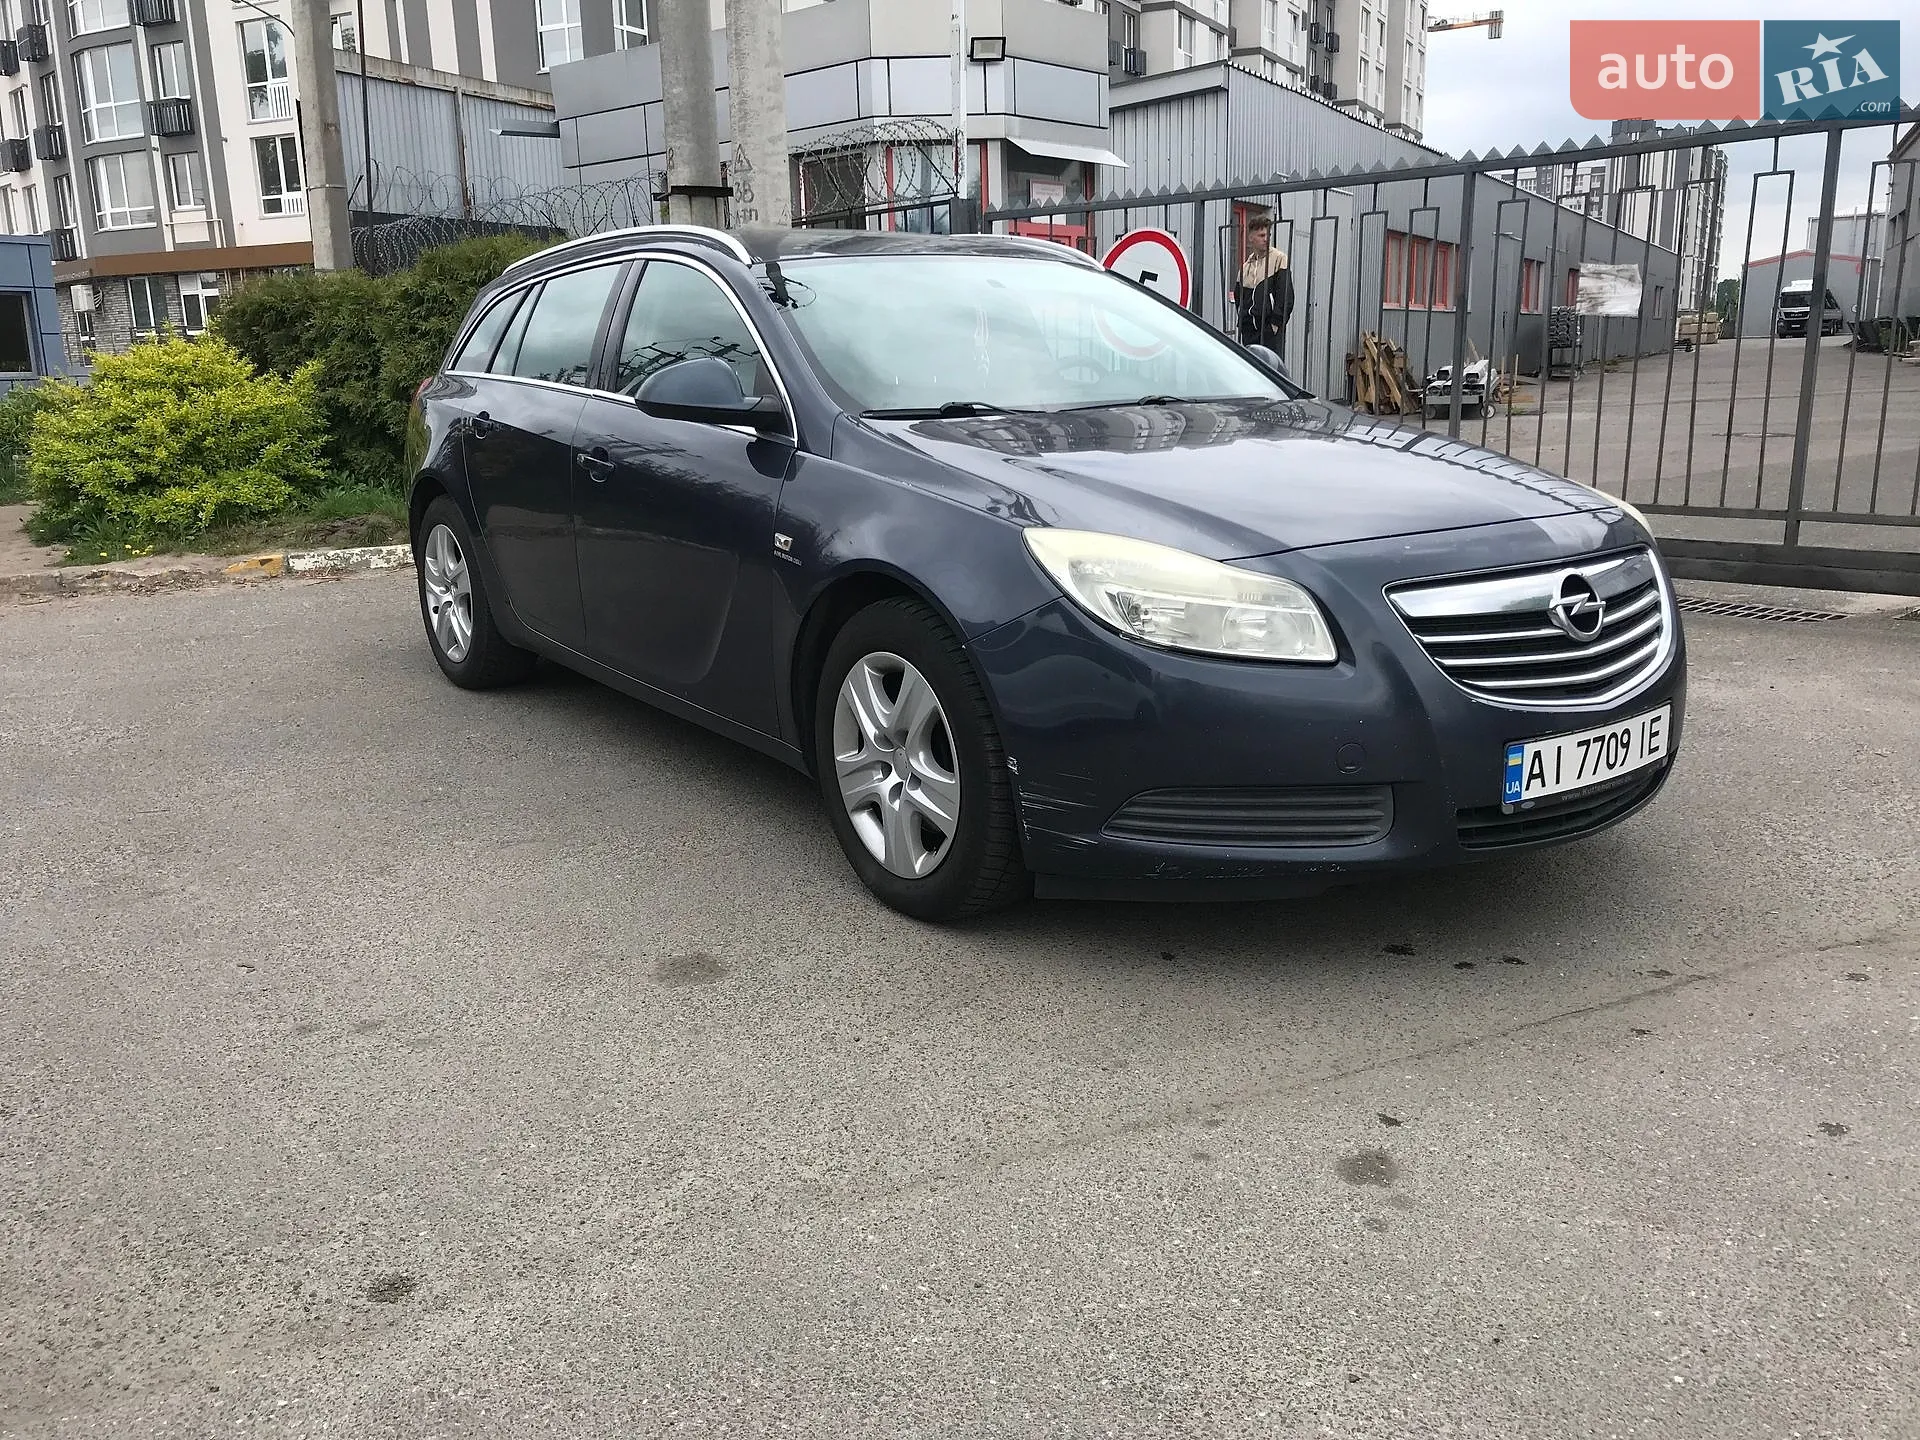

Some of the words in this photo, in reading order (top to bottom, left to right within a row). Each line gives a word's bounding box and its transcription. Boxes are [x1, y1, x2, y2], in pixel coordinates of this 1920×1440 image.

[1525, 745, 1562, 791] AI
[1576, 727, 1632, 780] 7709
[1639, 715, 1662, 759] IE
[1505, 781, 1521, 794] UA
